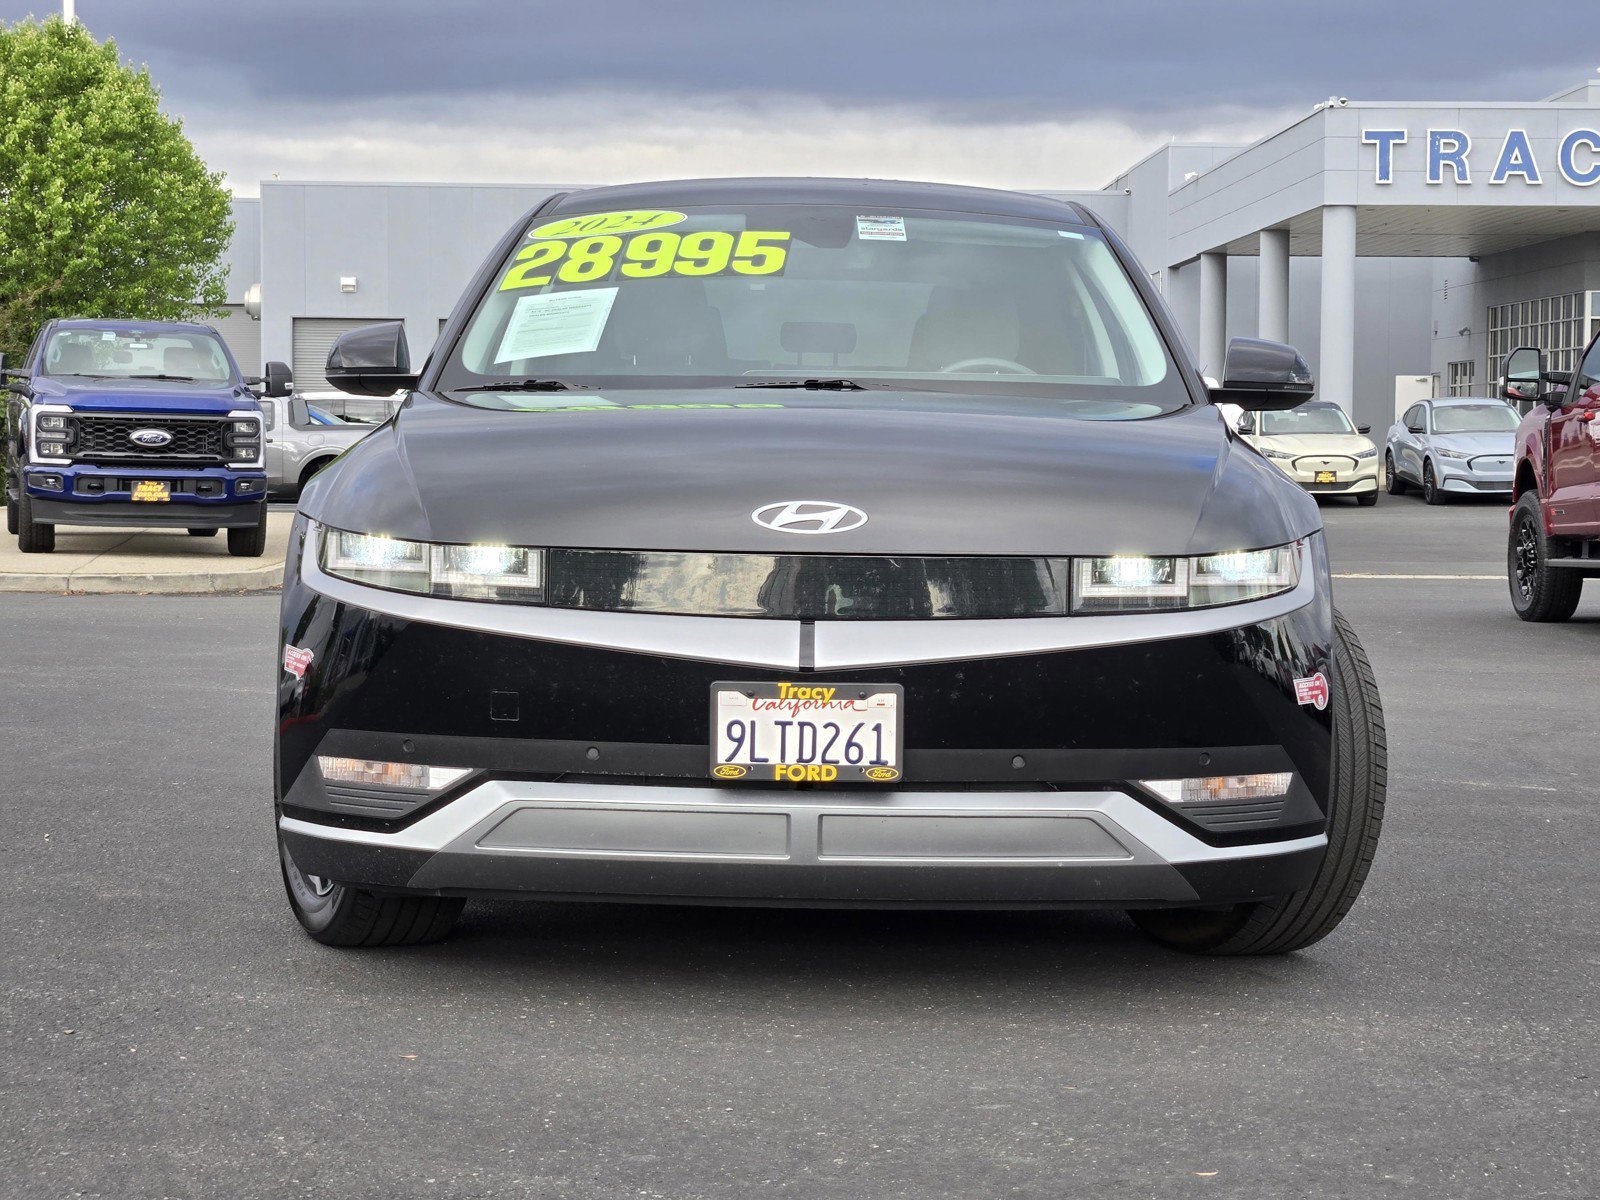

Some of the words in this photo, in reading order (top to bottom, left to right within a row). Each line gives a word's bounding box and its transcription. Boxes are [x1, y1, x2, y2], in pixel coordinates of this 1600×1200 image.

[1361, 128, 1600, 187] TRAC
[551, 213, 664, 236] 2024
[498, 231, 791, 292] 28995
[777, 682, 836, 704] Tracy
[752, 698, 868, 718] California
[724, 719, 889, 766] 9LTD261
[719, 766, 740, 777] Ford
[775, 764, 838, 782] FORD
[871, 768, 892, 779] Ford
